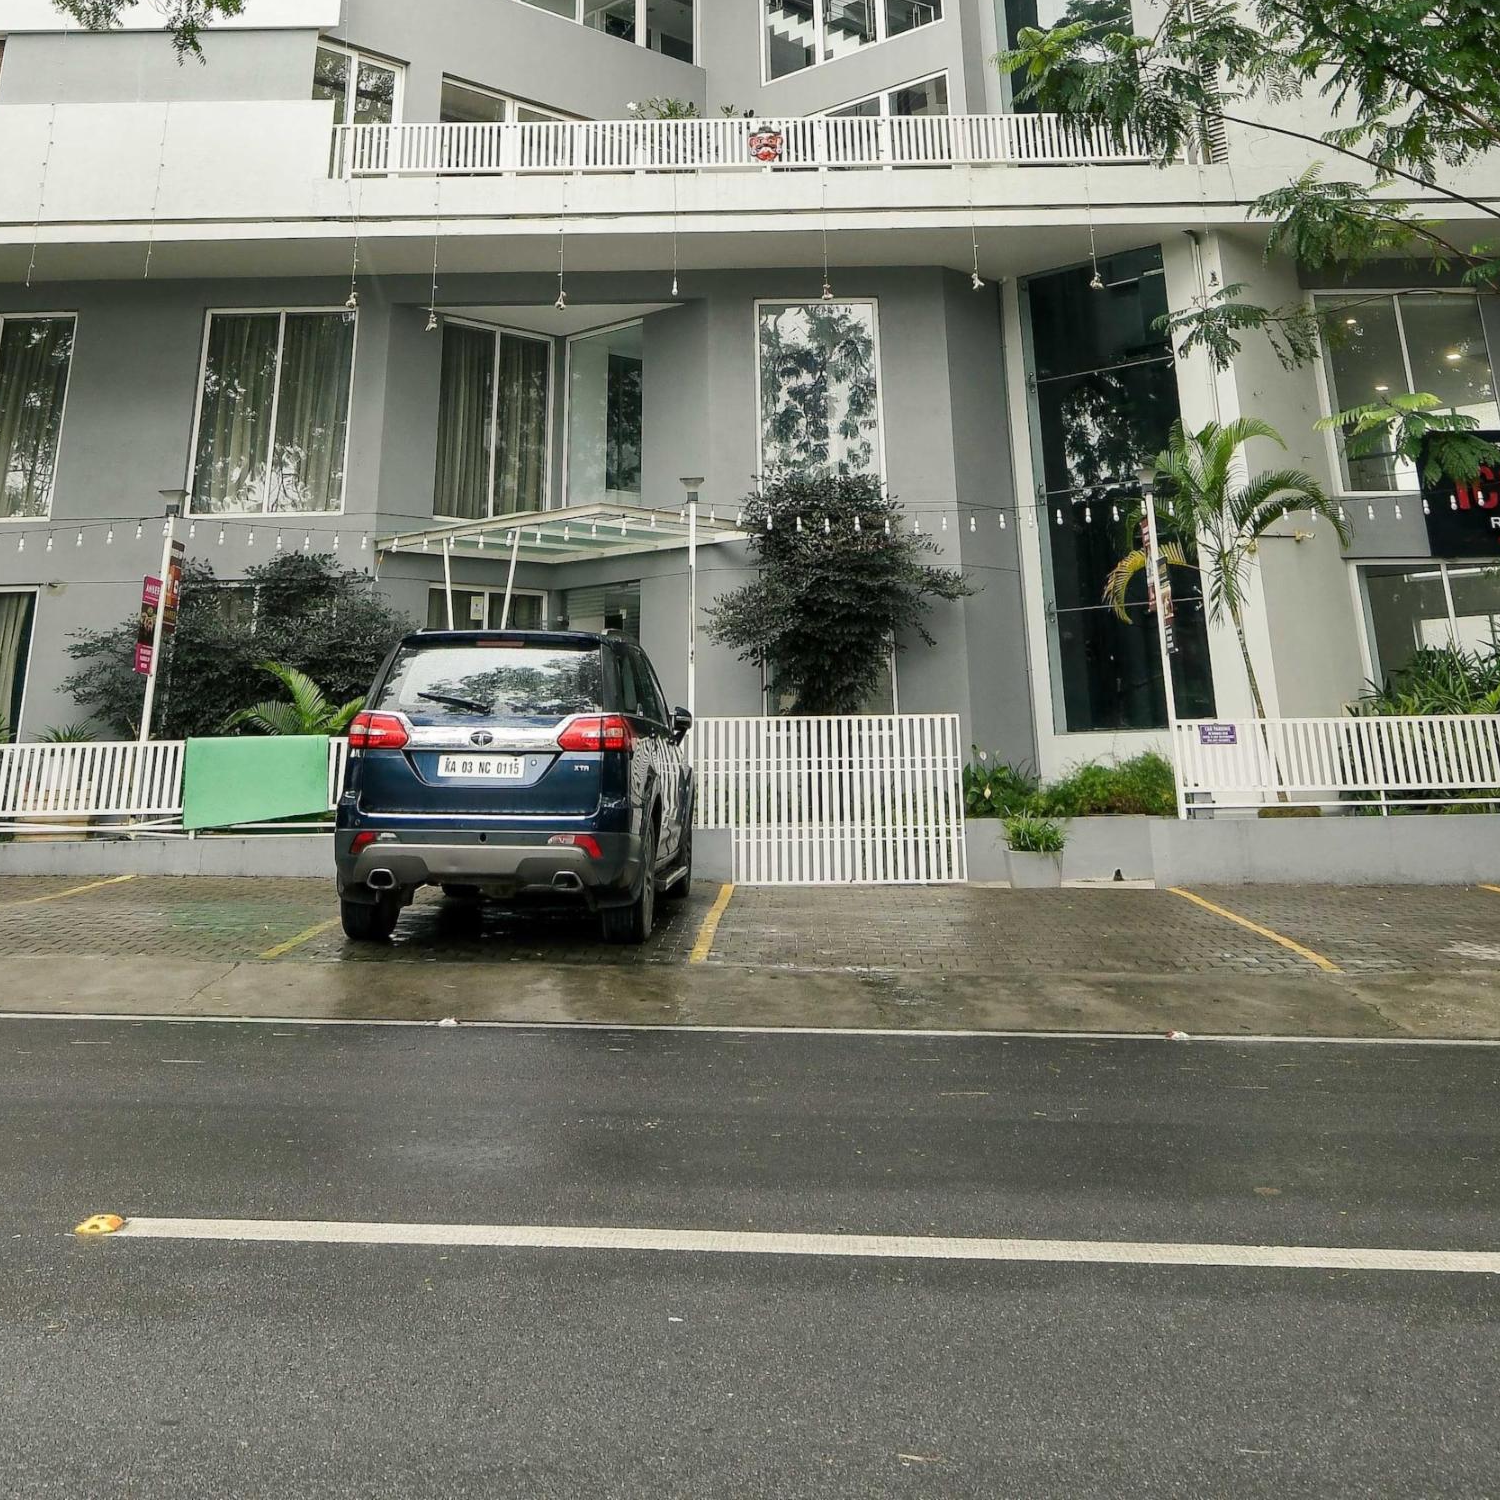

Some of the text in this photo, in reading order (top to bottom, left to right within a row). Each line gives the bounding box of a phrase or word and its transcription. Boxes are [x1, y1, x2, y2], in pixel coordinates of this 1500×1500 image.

[444, 760, 520, 775] KA 03 NC 0115
